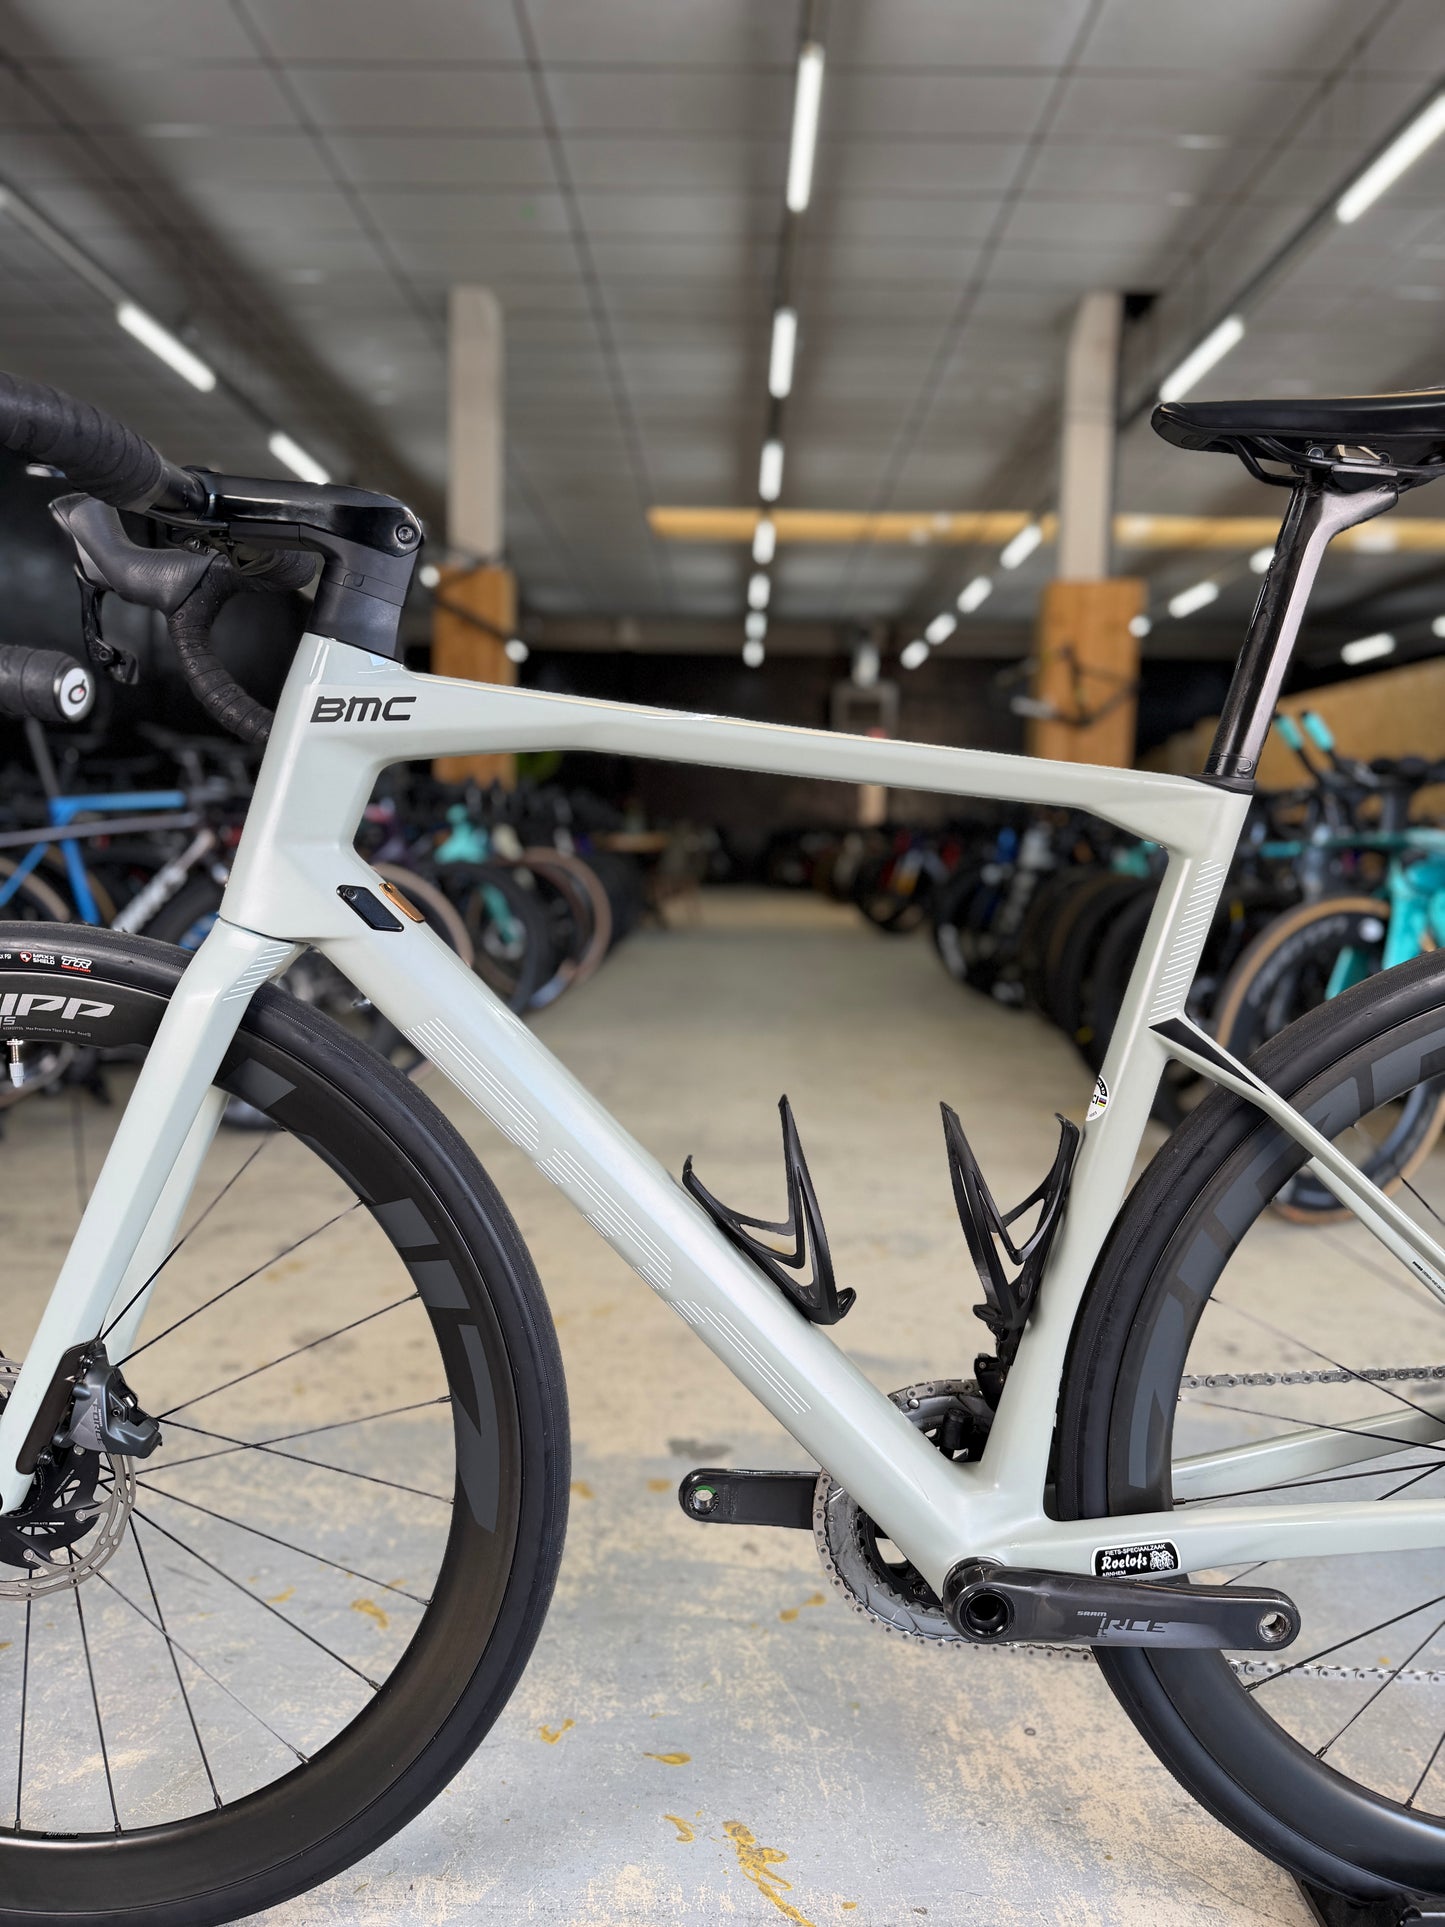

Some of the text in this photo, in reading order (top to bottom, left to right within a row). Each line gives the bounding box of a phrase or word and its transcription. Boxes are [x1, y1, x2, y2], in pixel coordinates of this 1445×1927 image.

[310, 696, 417, 723] BMC
[61, 955, 92, 969] TR
[0, 993, 115, 1020] IPP
[1105, 1544, 1166, 1556] FIETS-SPECIAALZAAK
[1101, 1553, 1148, 1570] Roelofs
